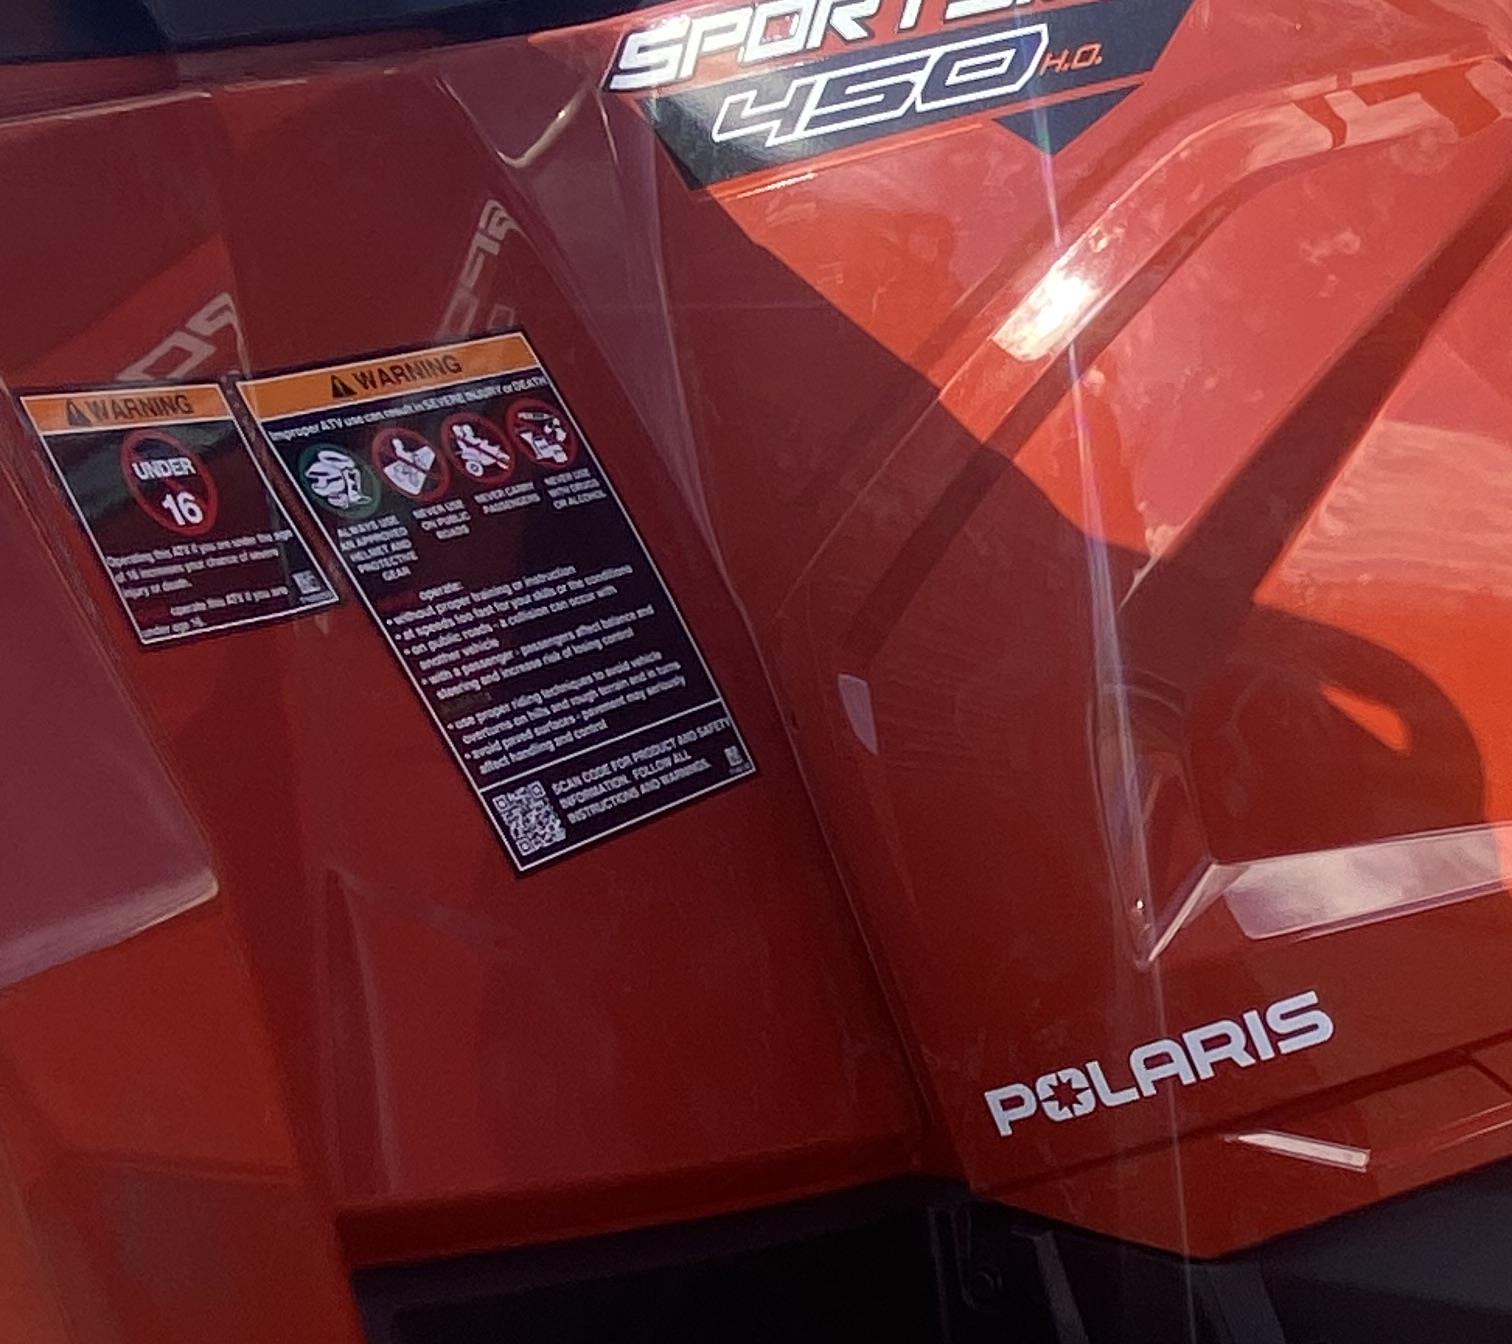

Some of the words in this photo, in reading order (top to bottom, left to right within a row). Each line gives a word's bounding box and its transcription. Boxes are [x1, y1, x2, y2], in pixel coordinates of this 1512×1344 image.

[711, 22, 1049, 148] 450
[1039, 42, 1103, 76] H.O.
[353, 355, 463, 391] WARNING
[87, 395, 194, 422] WARNING
[132, 457, 195, 479] UNDER
[162, 492, 202, 525] 16
[983, 989, 1335, 1137] POLARIS
